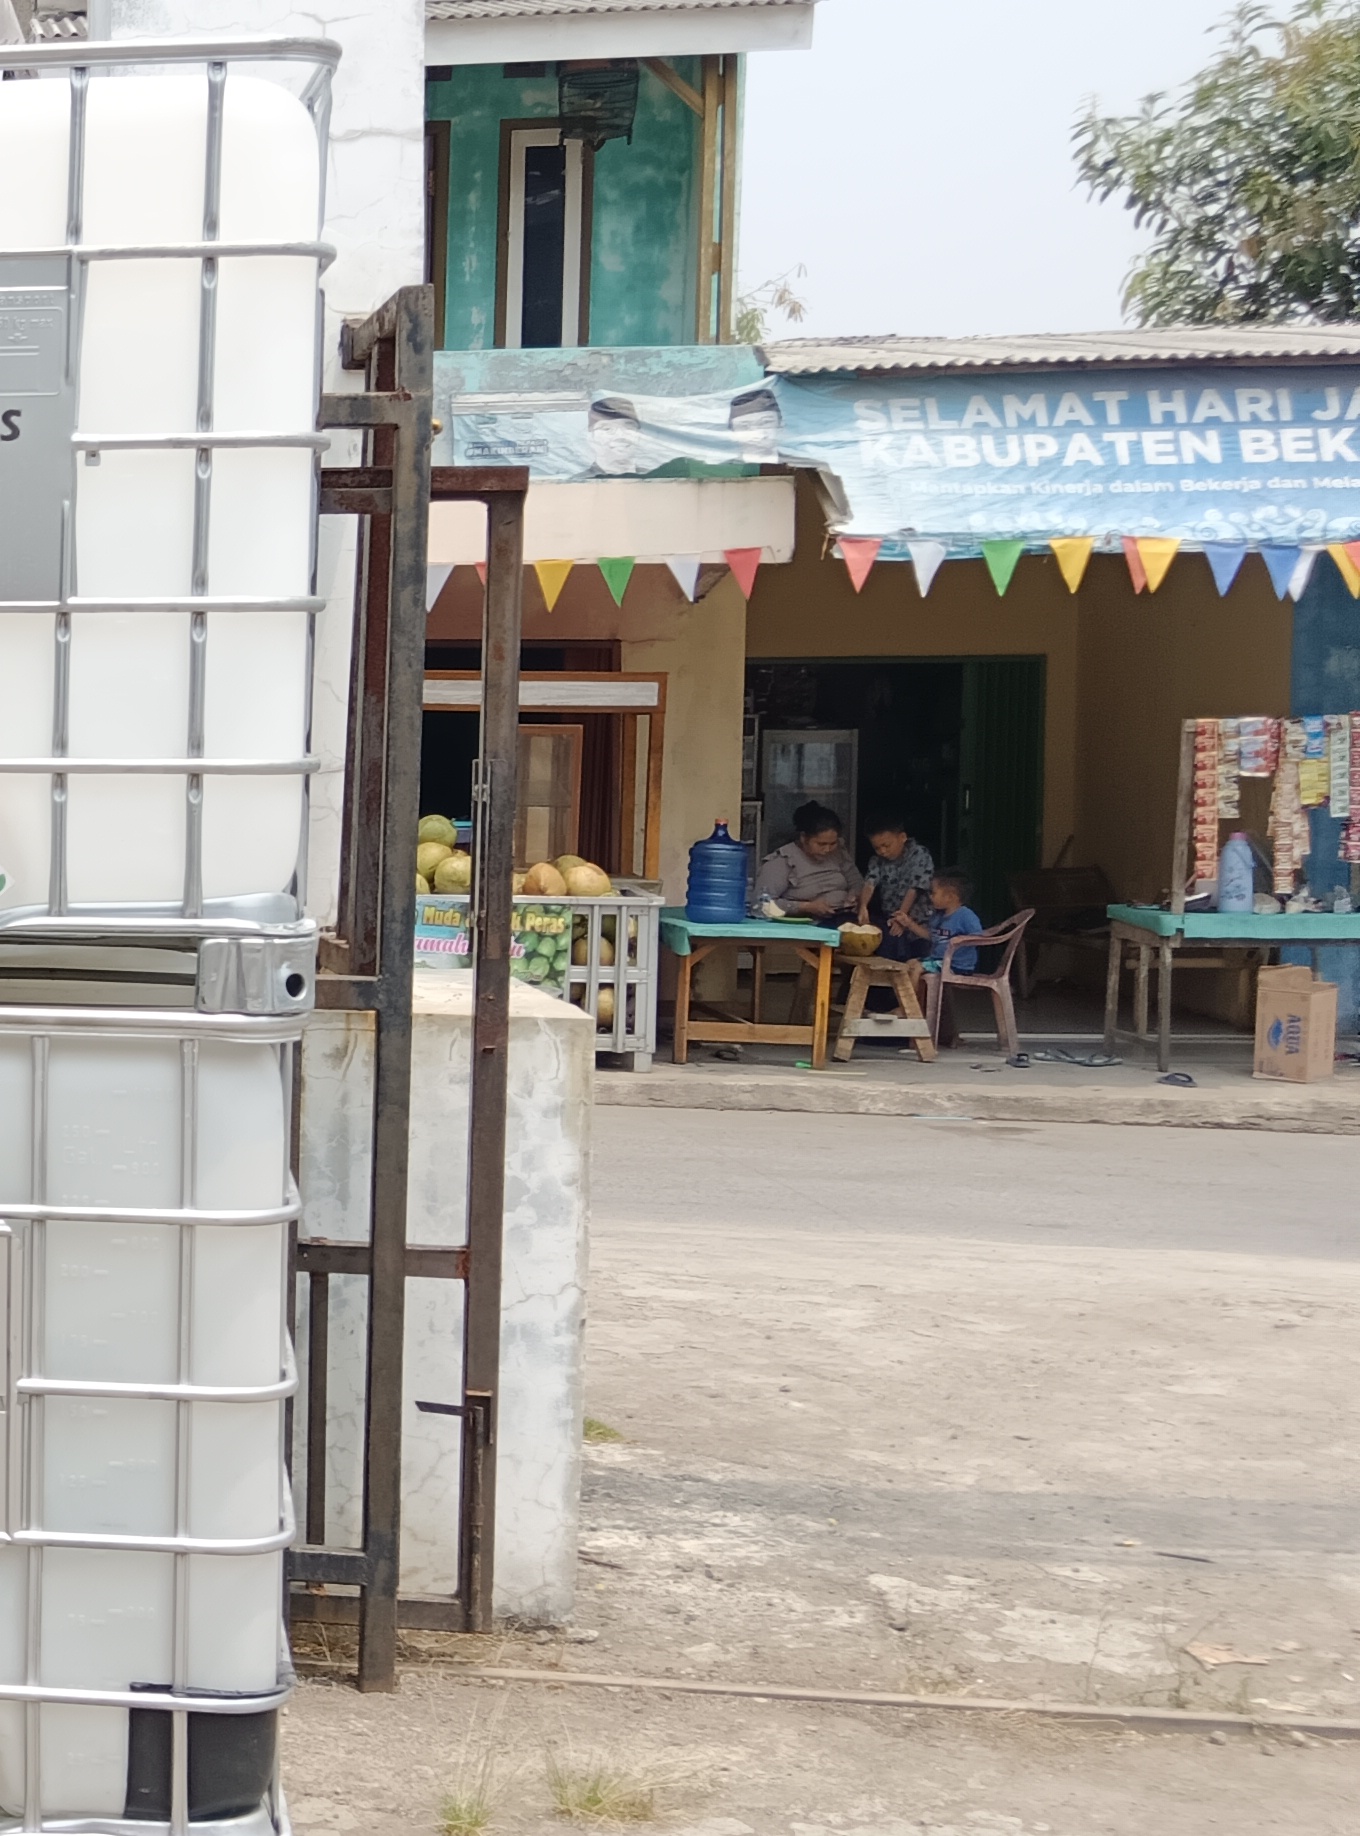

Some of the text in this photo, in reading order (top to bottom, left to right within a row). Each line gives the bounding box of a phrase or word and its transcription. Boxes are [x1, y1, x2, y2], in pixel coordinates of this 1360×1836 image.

[853, 390, 1128, 430] SELAMAT
[1147, 388, 1293, 425] HARI
[859, 428, 1221, 468] KABUPATEN
[1031, 480, 1104, 496] Kinerja
[1109, 480, 1175, 493] dalam
[1180, 477, 1262, 493] Bekerja
[1267, 477, 1308, 489] dan
[423, 906, 460, 926] Muda
[1285, 1014, 1301, 1055] AQUA
